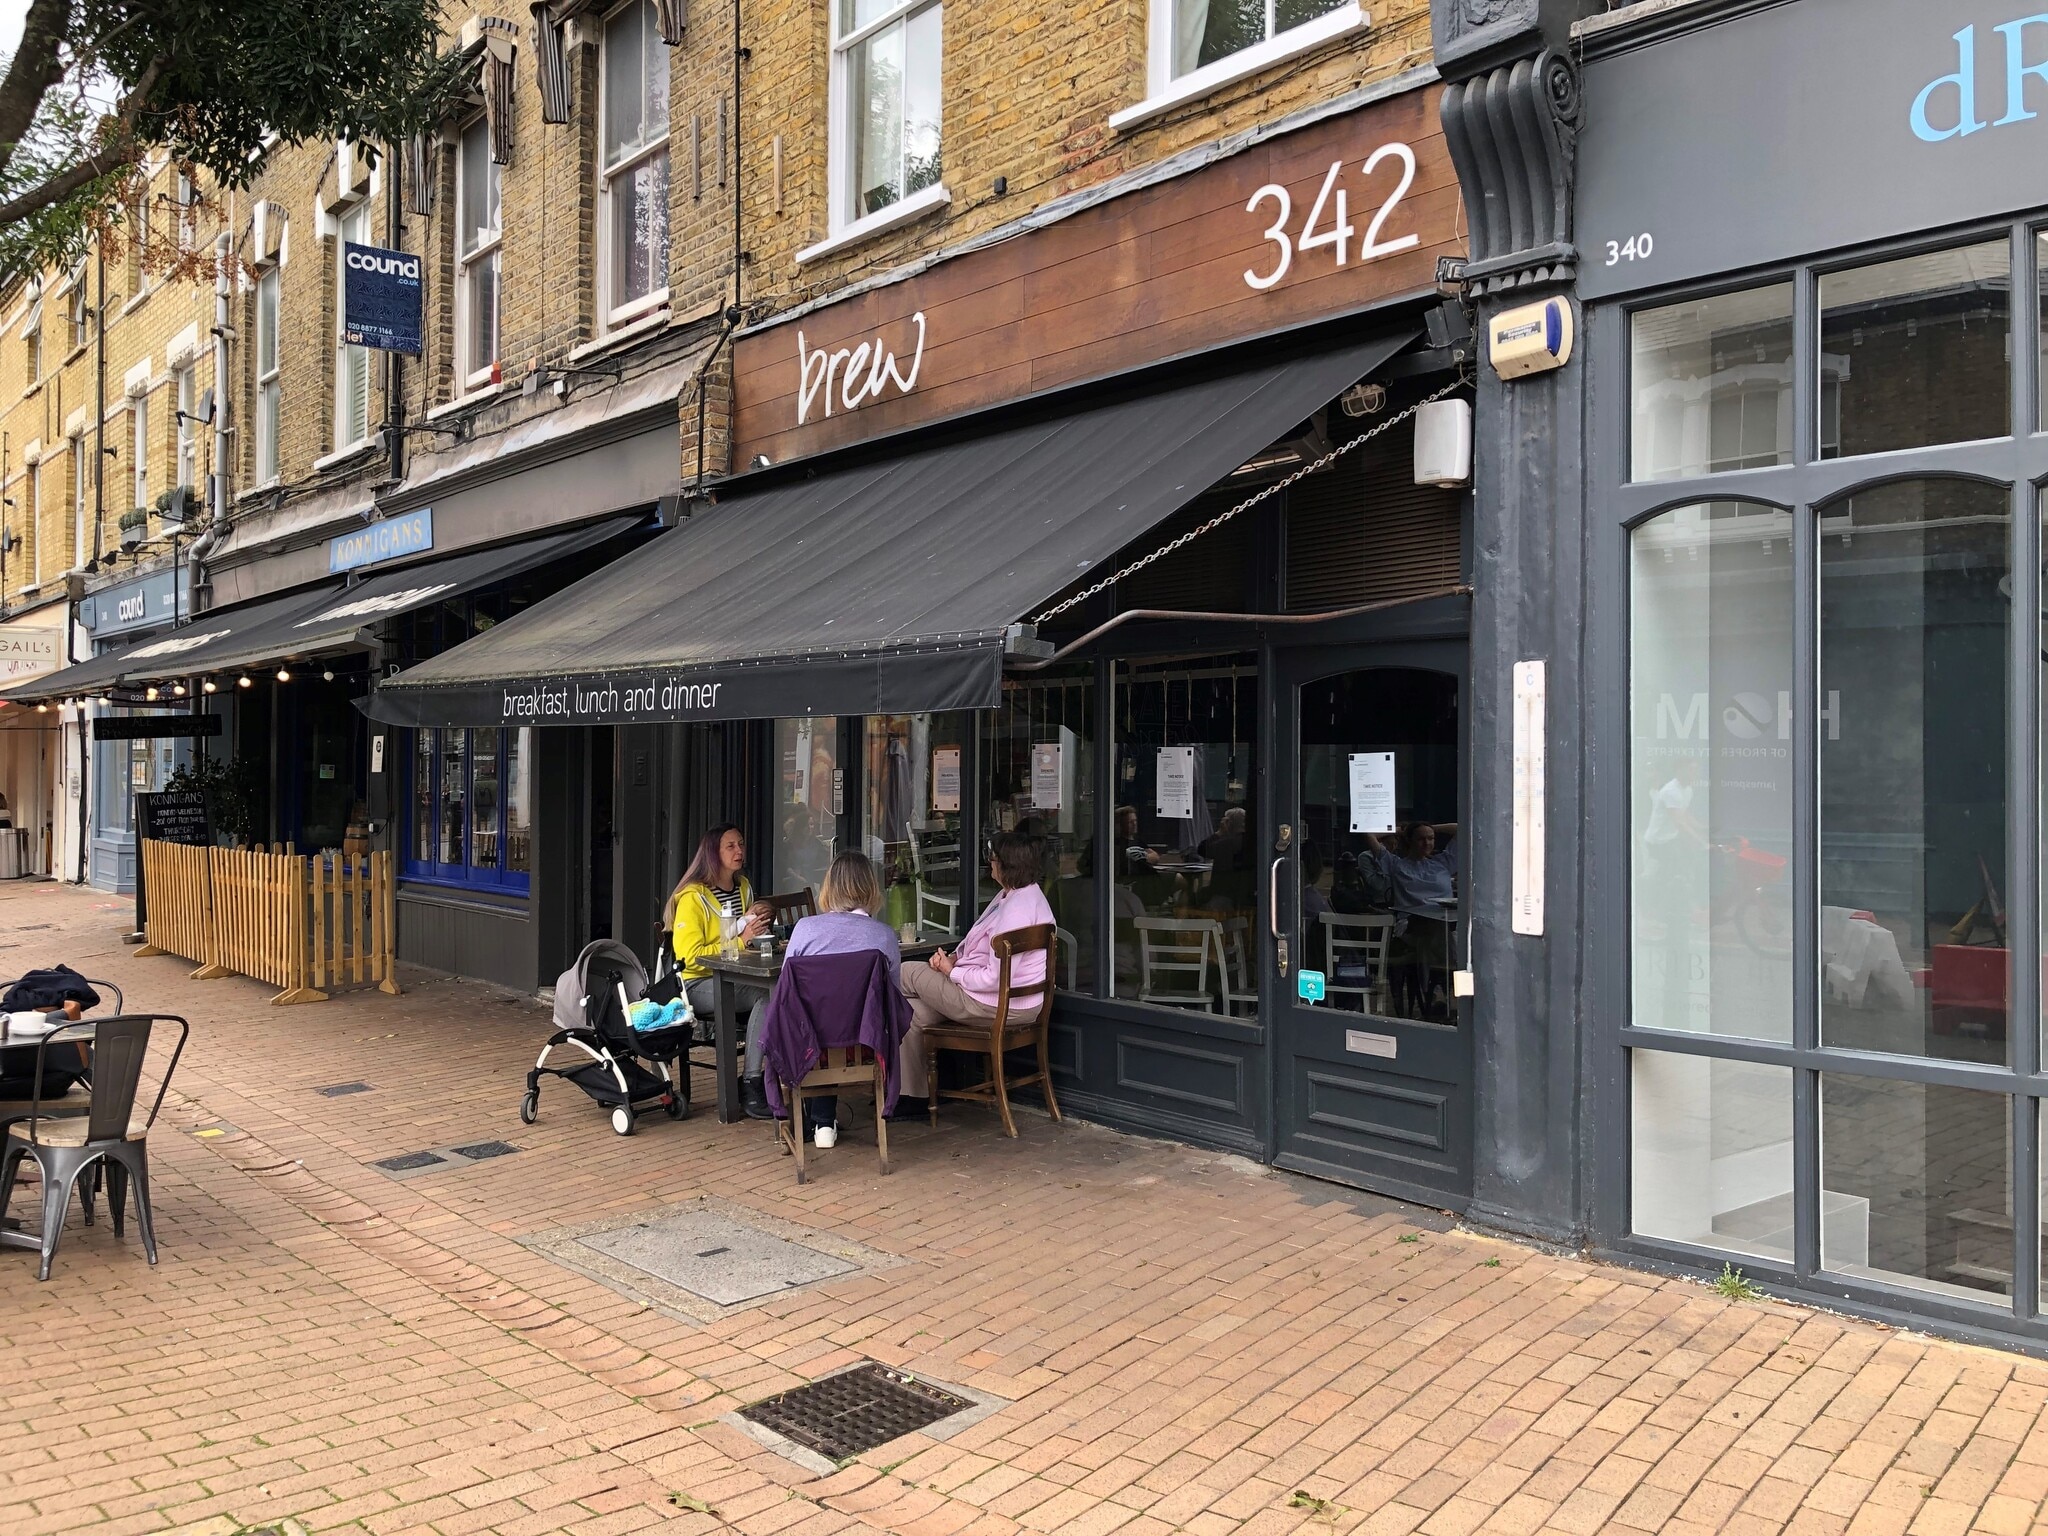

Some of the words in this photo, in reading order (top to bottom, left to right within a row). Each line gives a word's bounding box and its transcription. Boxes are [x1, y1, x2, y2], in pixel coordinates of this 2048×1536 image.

[1243, 141, 1419, 290] 342
[1605, 232, 1653, 266] 340
[346, 252, 419, 279] cound
[396, 278, 419, 287] .co.uk
[346, 330, 364, 343] let
[347, 322, 360, 330] 020
[360, 324, 378, 333] 8877
[378, 327, 393, 335] 1166
[797, 311, 927, 425] brew
[336, 518, 422, 564] KONNIGANS
[118, 589, 144, 621] cound
[130, 694, 145, 702] 020
[502, 685, 570, 718] breakfast,
[575, 682, 618, 714] lunch
[623, 678, 656, 712] and
[661, 677, 722, 710] dinner
[149, 791, 204, 806] KONNIGANS
